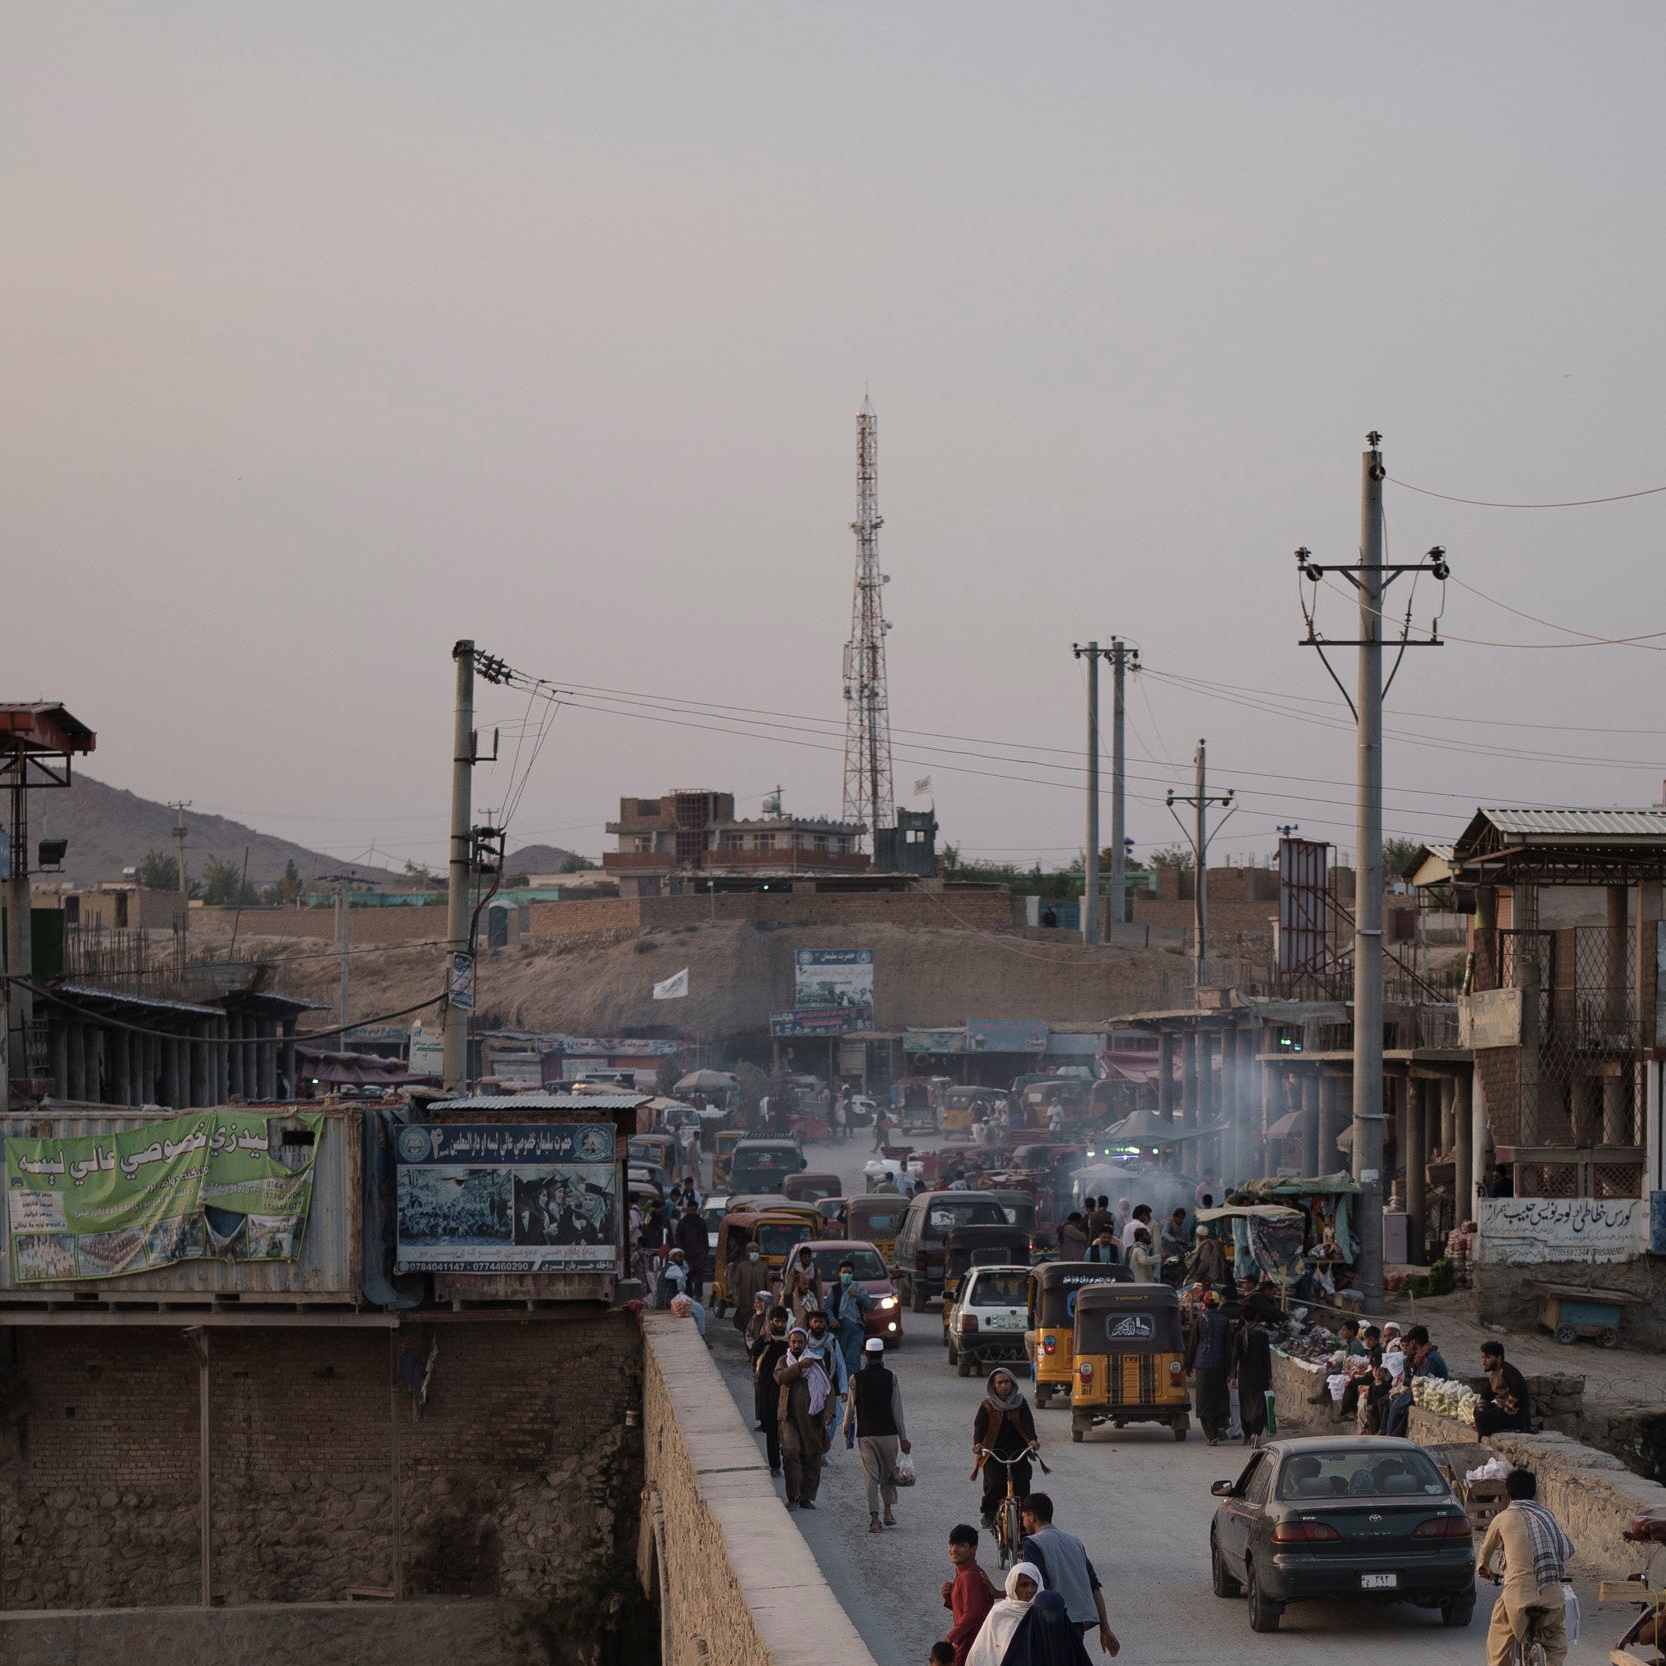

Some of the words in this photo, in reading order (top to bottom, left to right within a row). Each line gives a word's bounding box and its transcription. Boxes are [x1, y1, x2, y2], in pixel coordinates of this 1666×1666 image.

[120, 1122, 207, 1180] خصوصي
[19, 1149, 65, 1187] لیسه
[69, 1145, 115, 1187] عالي
[1553, 1201, 1572, 1225] لوحه
[1573, 1200, 1605, 1232] خطاطی
[1605, 1201, 1638, 1227] کورس
[410, 1262, 465, 1271] 0784041147
[473, 1262, 529, 1271] 0774460290
